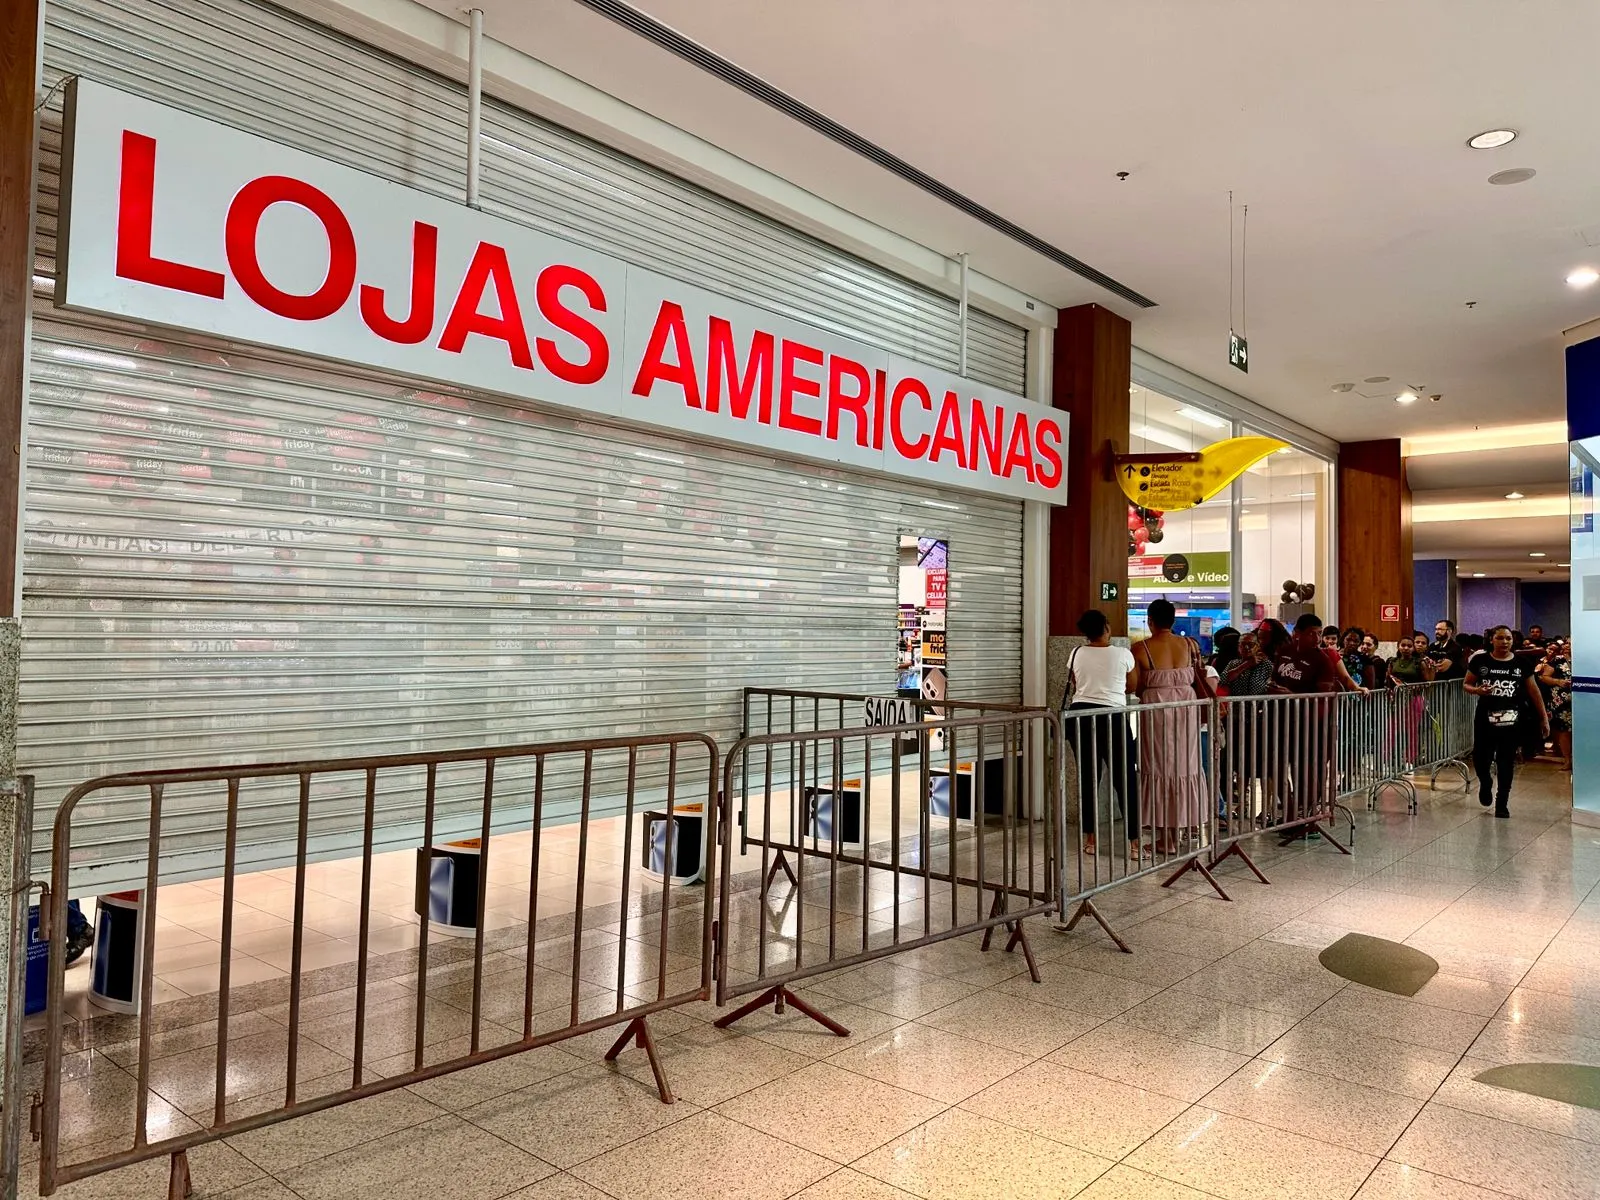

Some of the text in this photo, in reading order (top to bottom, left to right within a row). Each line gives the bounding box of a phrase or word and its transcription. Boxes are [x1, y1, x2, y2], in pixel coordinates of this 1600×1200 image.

[115, 129, 1063, 490] LOJAS AMERICANAS
[1151, 464, 1183, 472] Elevador
[1197, 571, 1229, 582] Vídeo
[931, 582, 941, 591] TV
